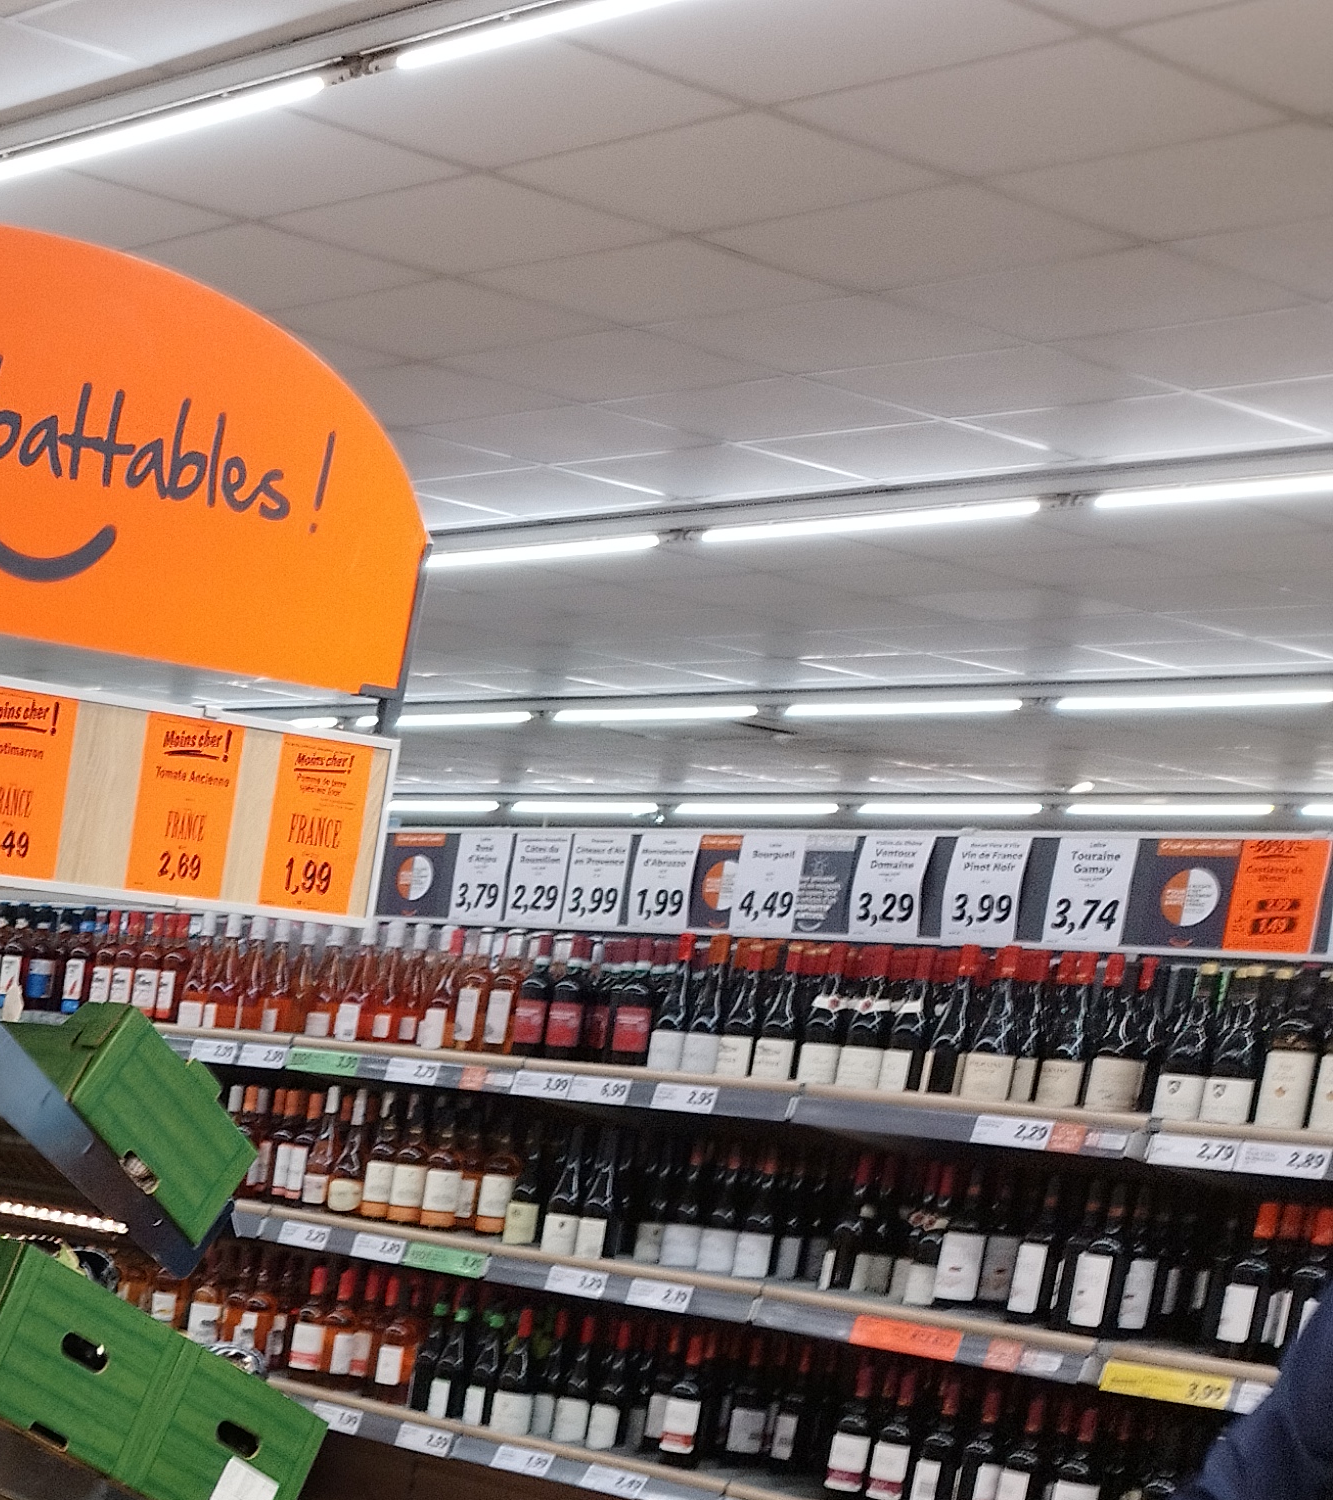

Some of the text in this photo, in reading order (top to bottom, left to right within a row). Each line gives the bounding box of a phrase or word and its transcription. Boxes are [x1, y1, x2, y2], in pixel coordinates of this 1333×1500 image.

[309, 430, 336, 534] !
[163, 730, 197, 747] Moins
[294, 753, 324, 767] Moins
[155, 766, 230, 788] Tomate Ancienne
[165, 810, 208, 842] FRANCE
[287, 813, 342, 849] FRANCE
[157, 851, 201, 881] 2,69
[870, 860, 915, 869] Domaine
[875, 849, 918, 858] Ventoux
[961, 851, 1023, 860] Vin de France
[963, 862, 1016, 872] Pinot Noir
[1071, 851, 1121, 861] Touraine
[285, 857, 332, 895] 1,99
[1074, 864, 1113, 876] Gamay
[455, 883, 499, 913] 3,79
[511, 884, 559, 915] 2,29
[567, 887, 618, 917] 3,99
[637, 888, 683, 920] 1,99
[738, 890, 793, 922] 4,49
[856, 892, 914, 927] 3,29
[951, 893, 1012, 927] 3,99
[1050, 898, 1120, 934] 3,74
[1013, 1124, 1048, 1141] 2,29
[1196, 1143, 1234, 1161] 2,79
[1286, 1152, 1326, 1170] 2,89
